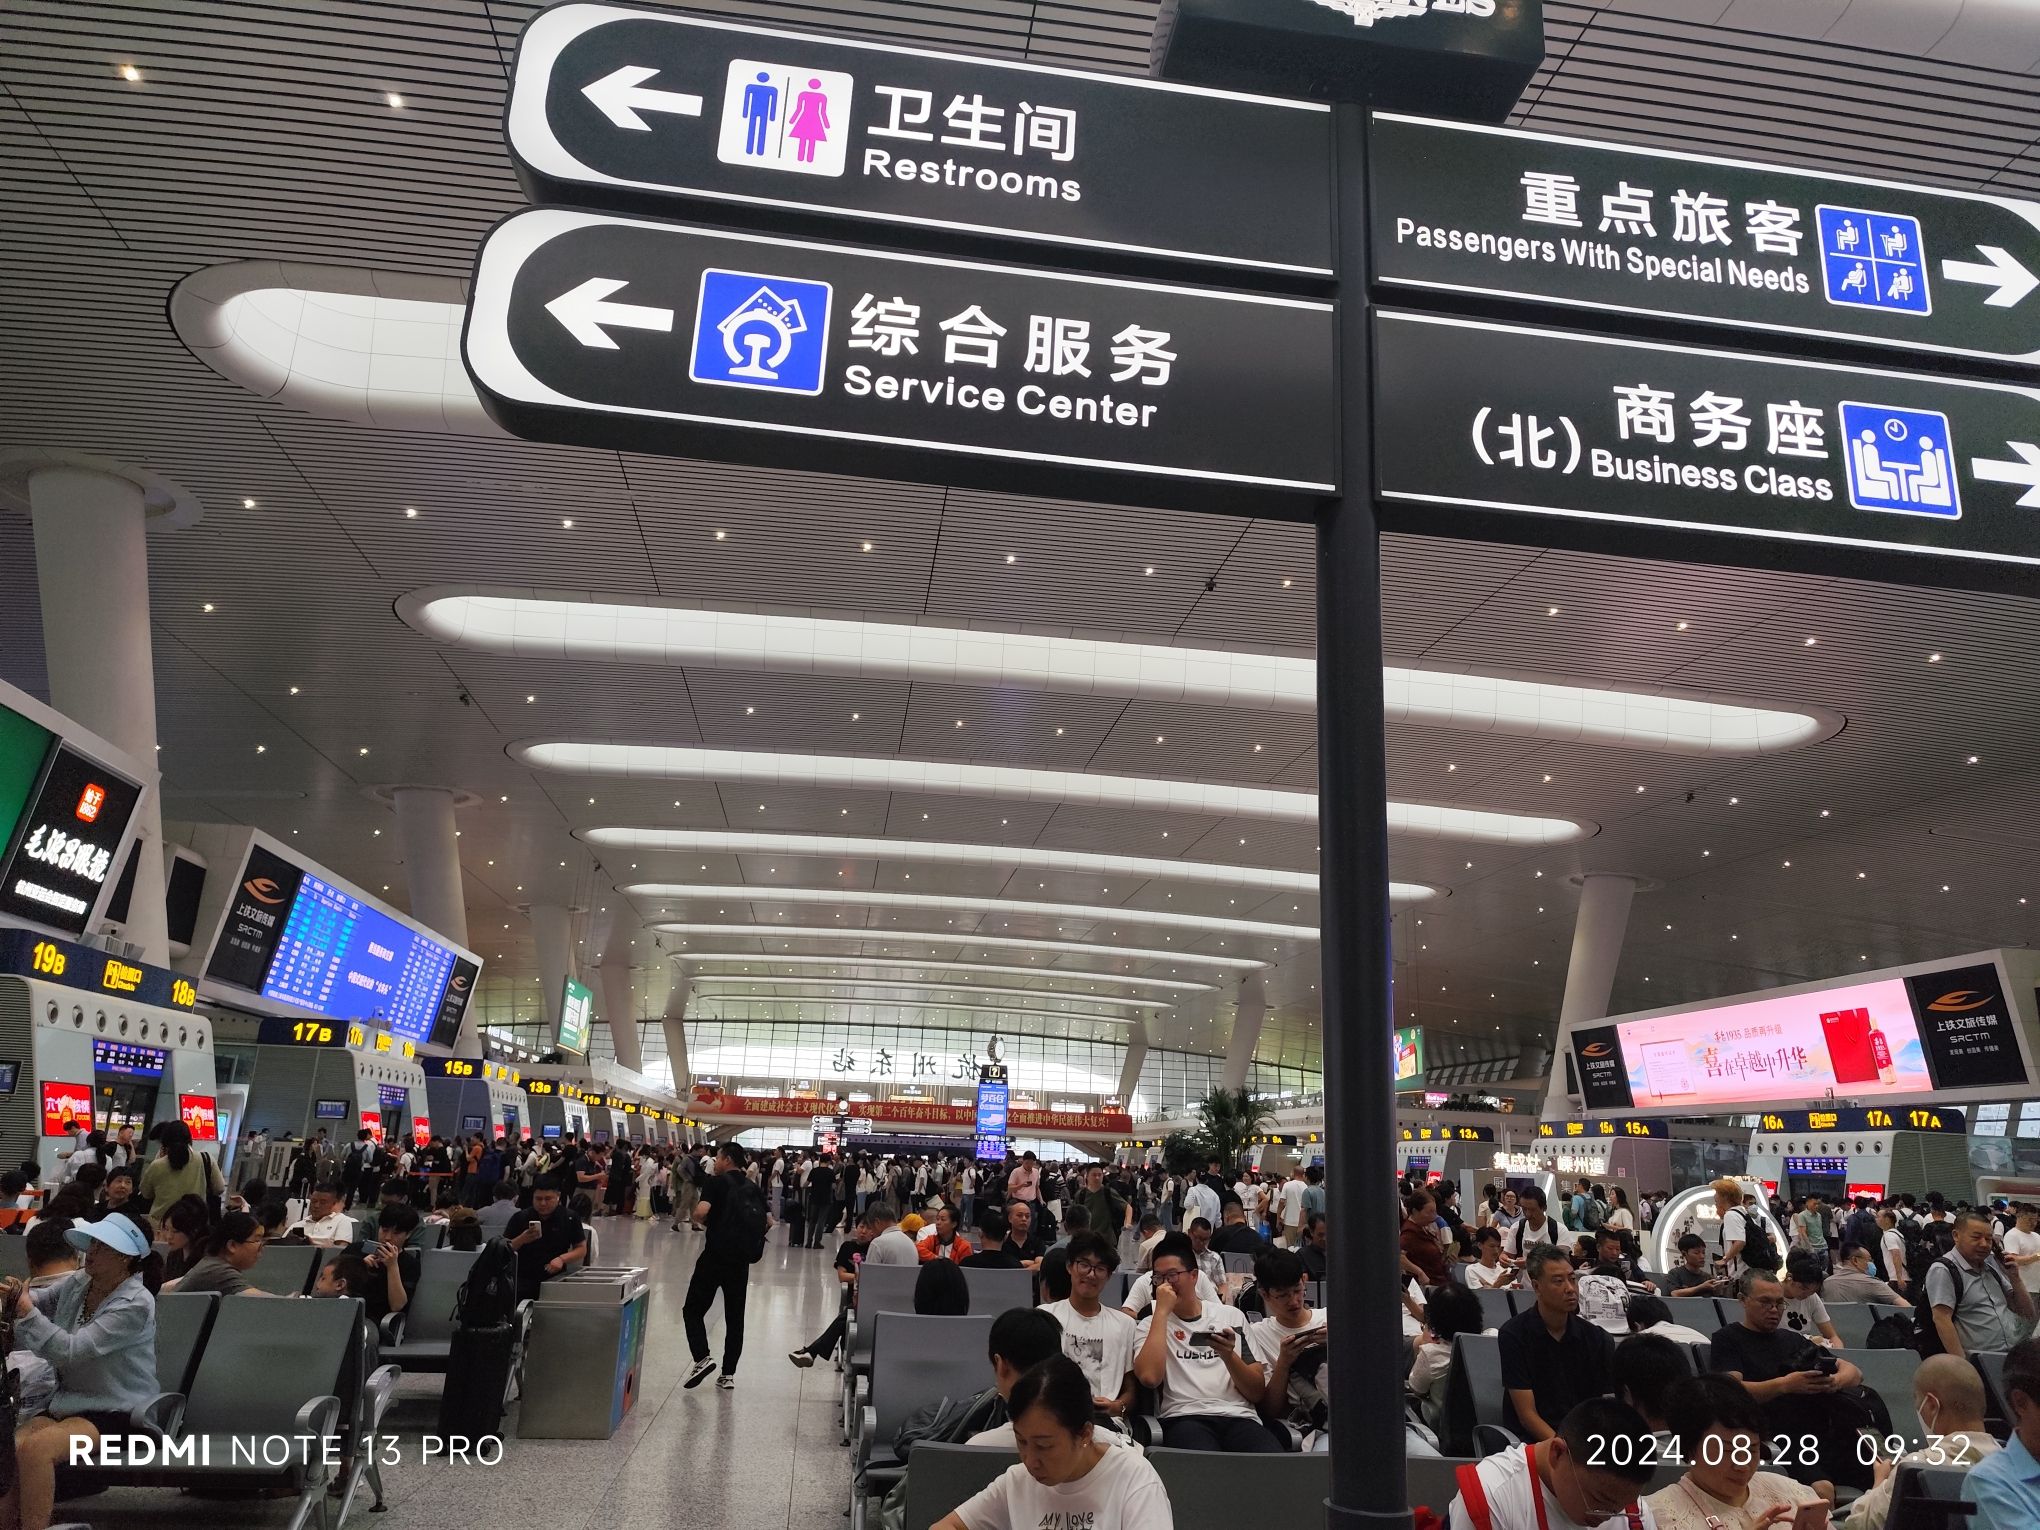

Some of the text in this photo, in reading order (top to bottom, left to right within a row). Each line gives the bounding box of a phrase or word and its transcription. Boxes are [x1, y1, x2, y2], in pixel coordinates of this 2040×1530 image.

[866, 84, 1077, 163] 卫生间
[863, 148, 1082, 202] Restrooms
[1519, 171, 1803, 257] 重点旅客
[1396, 217, 1809, 294] Passengers With Special Needs
[847, 292, 1178, 387] 综合服务
[844, 365, 1158, 428] Service Center
[1613, 383, 1829, 461] 商务座
[1591, 447, 1834, 502] Business Class
[33, 941, 66, 975] 19B
[172, 979, 196, 1007] 18B
[293, 1022, 332, 1042] 17B
[1936, 1014, 1998, 1032] 上铁文旅传媒
[1949, 1031, 1991, 1044] SRCTM
[444, 1061, 473, 1076] 15B
[1702, 1045, 1809, 1082] 喜在卓越中升华
[529, 1081, 551, 1094] 13B
[1625, 1122, 1650, 1136] 15A
[1762, 1115, 1784, 1130] 16A
[1866, 1111, 1892, 1127] 17A
[1909, 1111, 1941, 1128] 17A
[1459, 1128, 1479, 1140] 13A
